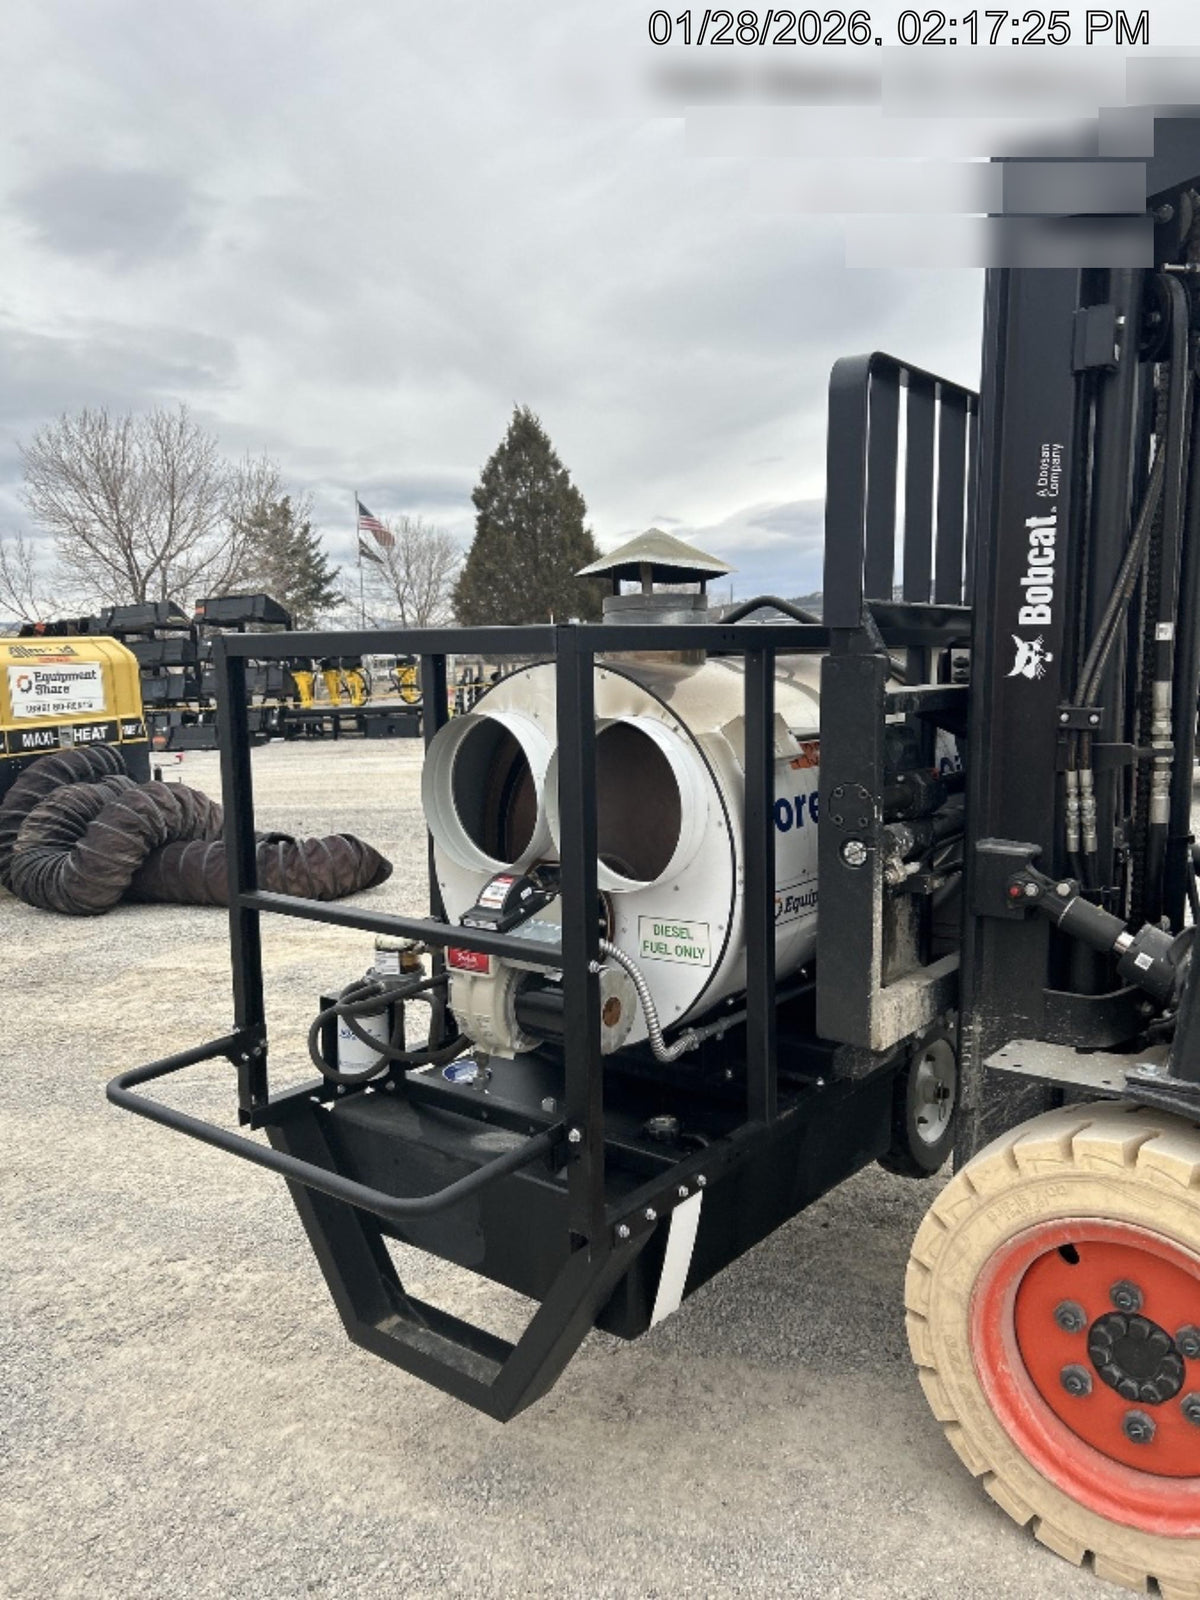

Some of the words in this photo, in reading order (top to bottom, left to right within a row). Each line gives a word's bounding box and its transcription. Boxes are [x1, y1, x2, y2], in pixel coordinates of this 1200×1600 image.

[1048, 443, 1065, 497] Company
[1018, 515, 1058, 625] Bobcat
[33, 669, 97, 683] Equipment
[34, 683, 70, 696] Share
[73, 725, 109, 742] HEAT
[653, 923, 694, 941] DIESEL
[643, 940, 673, 956] FUEL
[675, 944, 706, 960] ONLY
